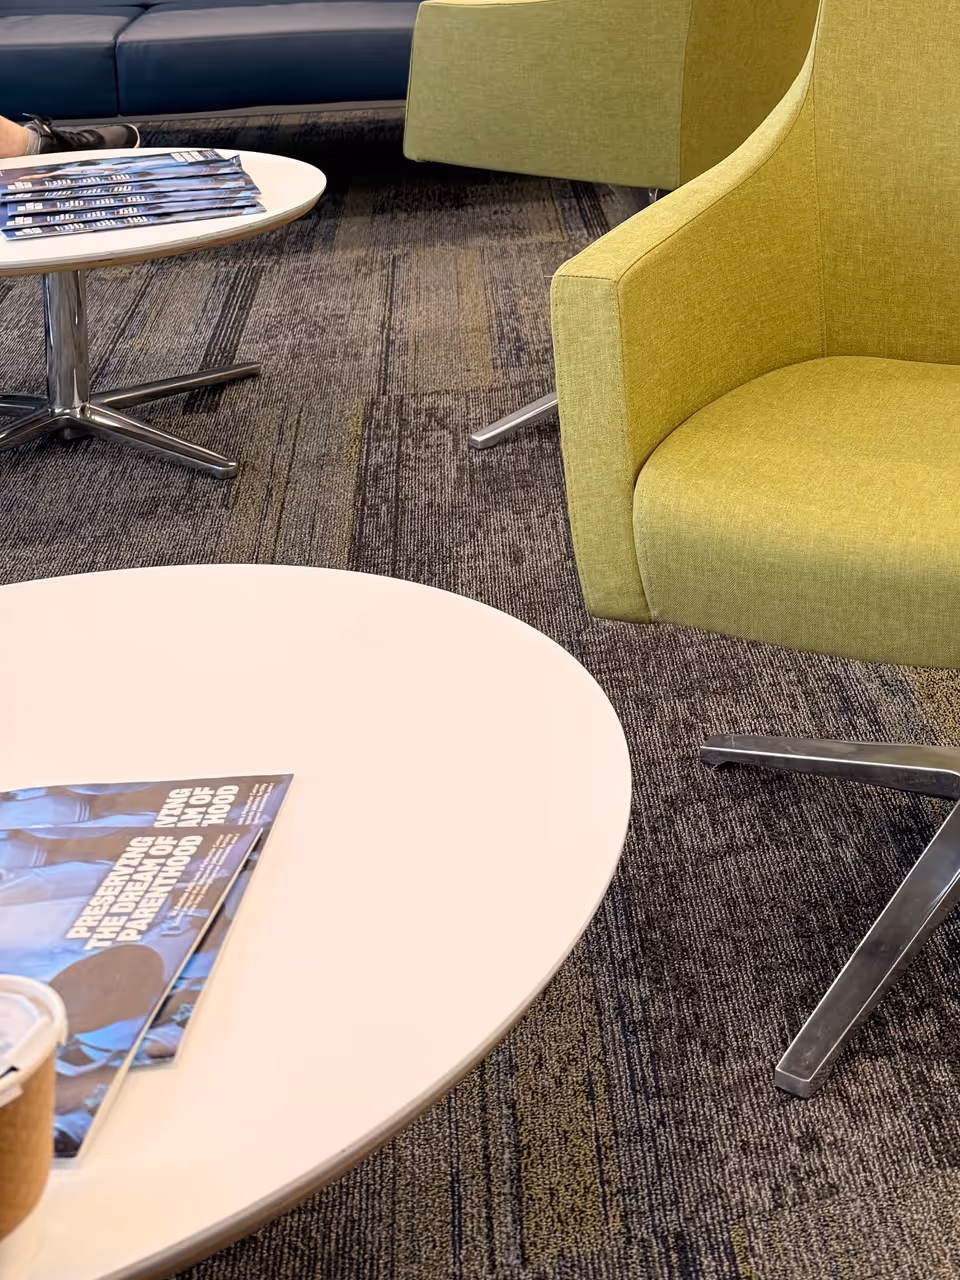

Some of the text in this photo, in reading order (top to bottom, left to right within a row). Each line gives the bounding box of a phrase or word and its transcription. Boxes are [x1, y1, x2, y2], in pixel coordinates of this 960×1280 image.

[193, 786, 216, 806] OF
[201, 784, 240, 828] HOOD
[65, 835, 156, 940] PRESERVING
[84, 835, 180, 951] THE DREAM OF
[116, 834, 204, 943] PARENTHOOD
